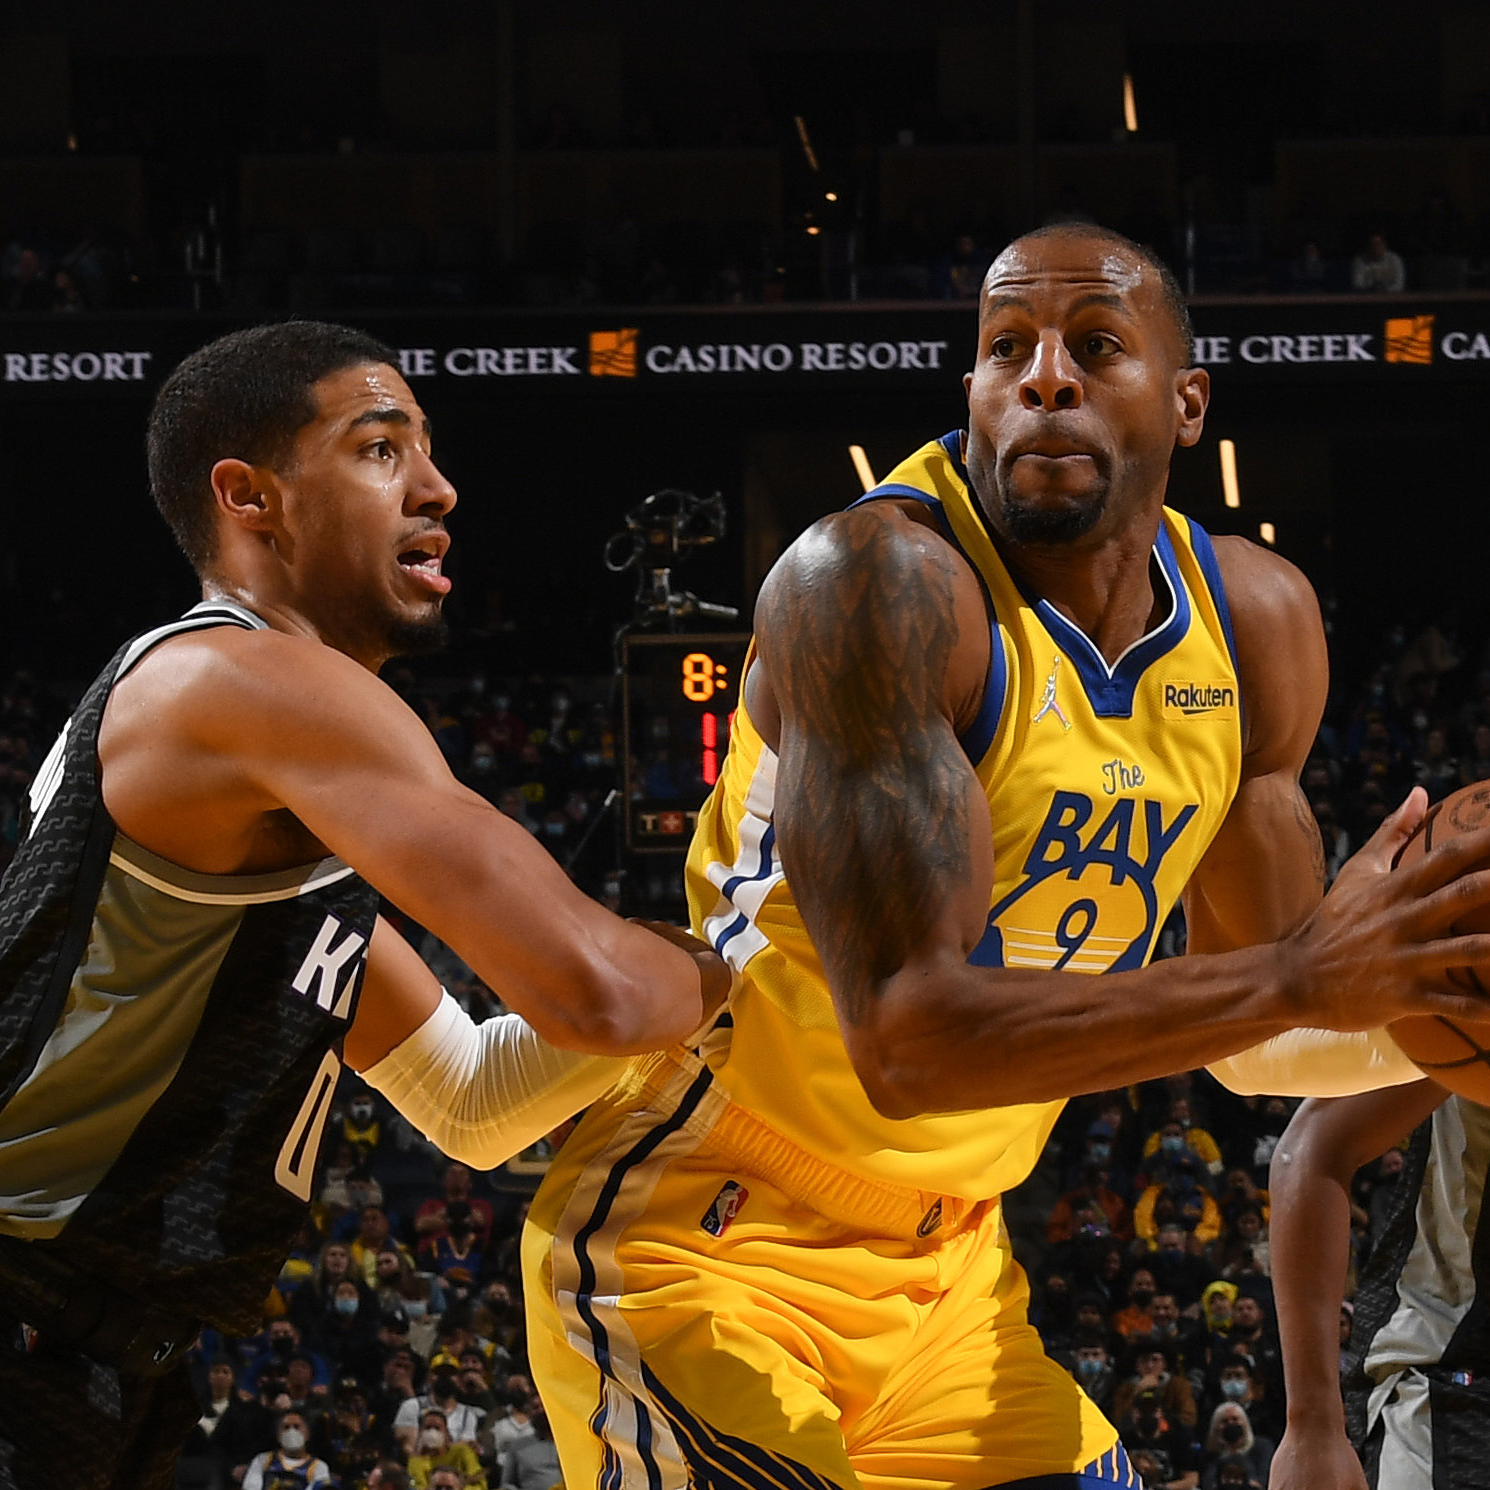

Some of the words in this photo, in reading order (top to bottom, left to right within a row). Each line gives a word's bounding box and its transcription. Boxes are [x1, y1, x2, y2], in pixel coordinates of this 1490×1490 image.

[444, 346, 582, 377] CREEK
[646, 343, 795, 375] CASINO
[801, 340, 949, 373] RESORT
[1239, 333, 1377, 364] CREEK
[5, 352, 153, 383] RESORT
[1164, 683, 1235, 709] Rakuten
[1101, 758, 1146, 795] The
[1021, 789, 1200, 886] BAY
[1054, 898, 1098, 971] 9
[274, 1047, 343, 1203] 0
